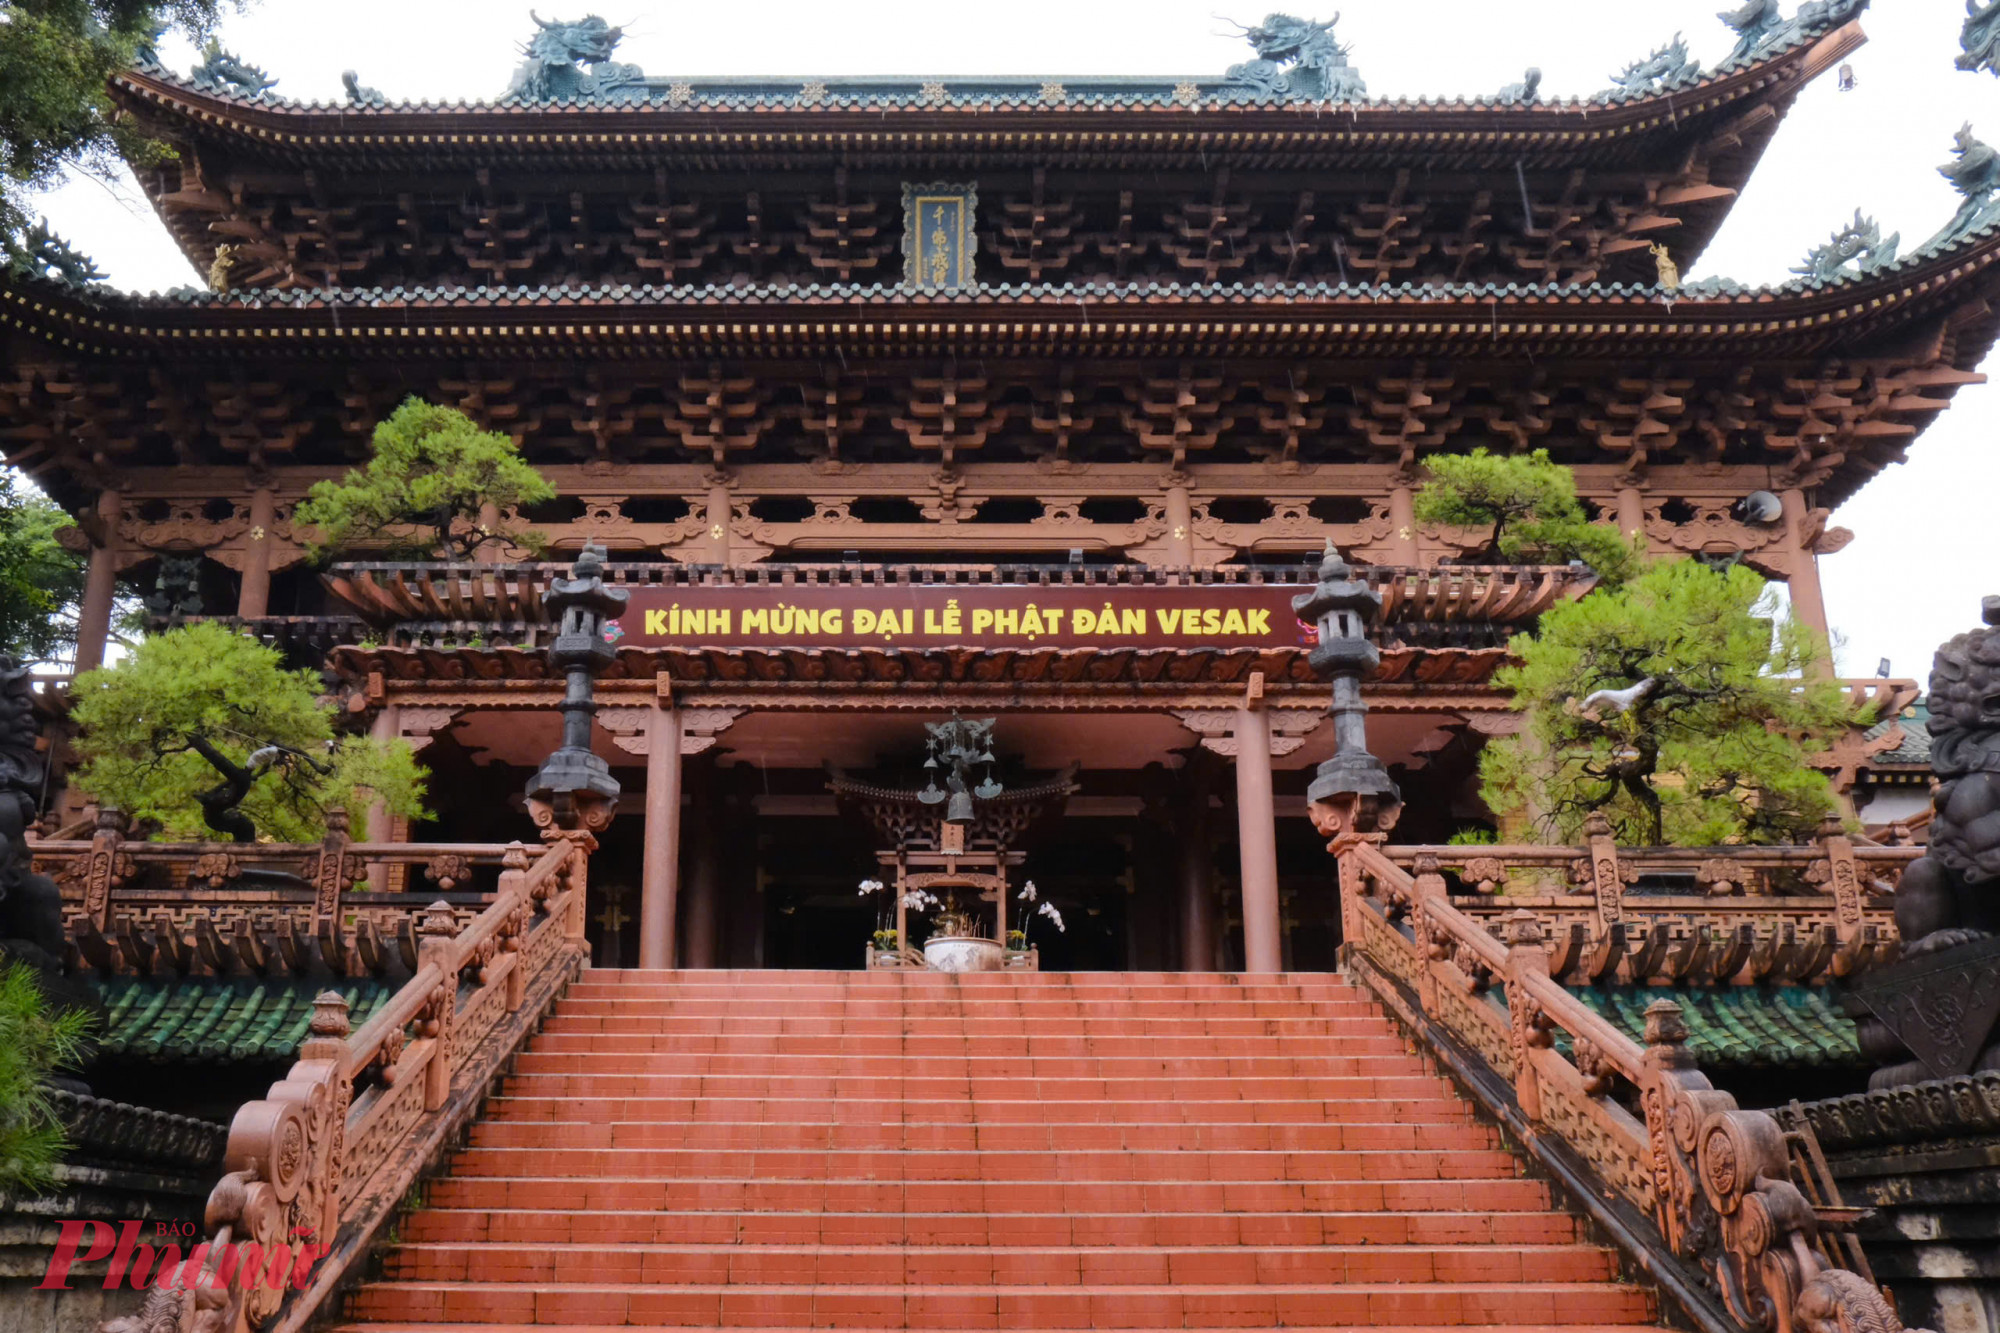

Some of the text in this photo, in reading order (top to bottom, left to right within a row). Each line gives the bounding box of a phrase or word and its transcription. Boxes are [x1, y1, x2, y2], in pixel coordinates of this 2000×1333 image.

[645, 599, 1271, 641] KÍNH MỪNG ĐẠI LỄ PHẬT ĐẢN VESAK
